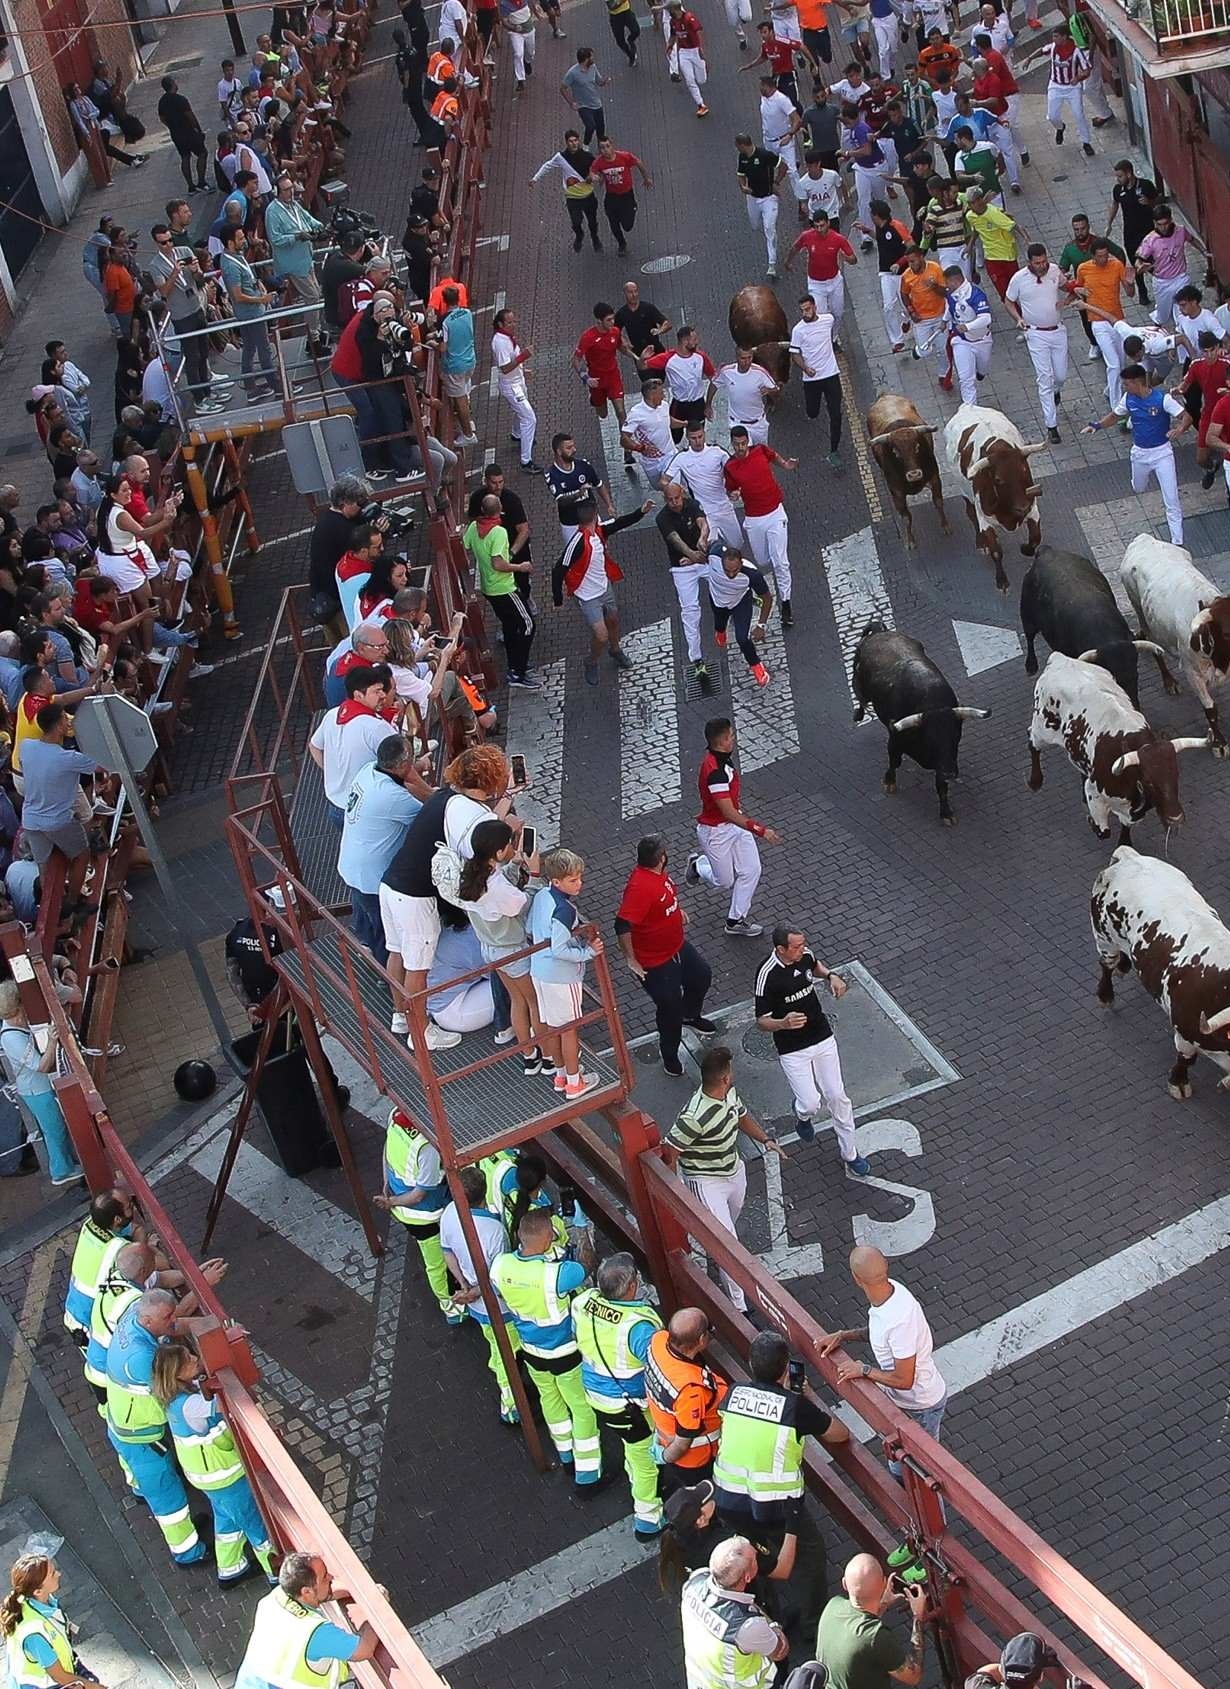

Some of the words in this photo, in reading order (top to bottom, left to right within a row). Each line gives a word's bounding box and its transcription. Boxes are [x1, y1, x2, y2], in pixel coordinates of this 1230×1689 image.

[811, 191, 831, 202] AIA
[730, 1396, 779, 1419] POLICIA
[686, 1593, 723, 1634] POLICIA
